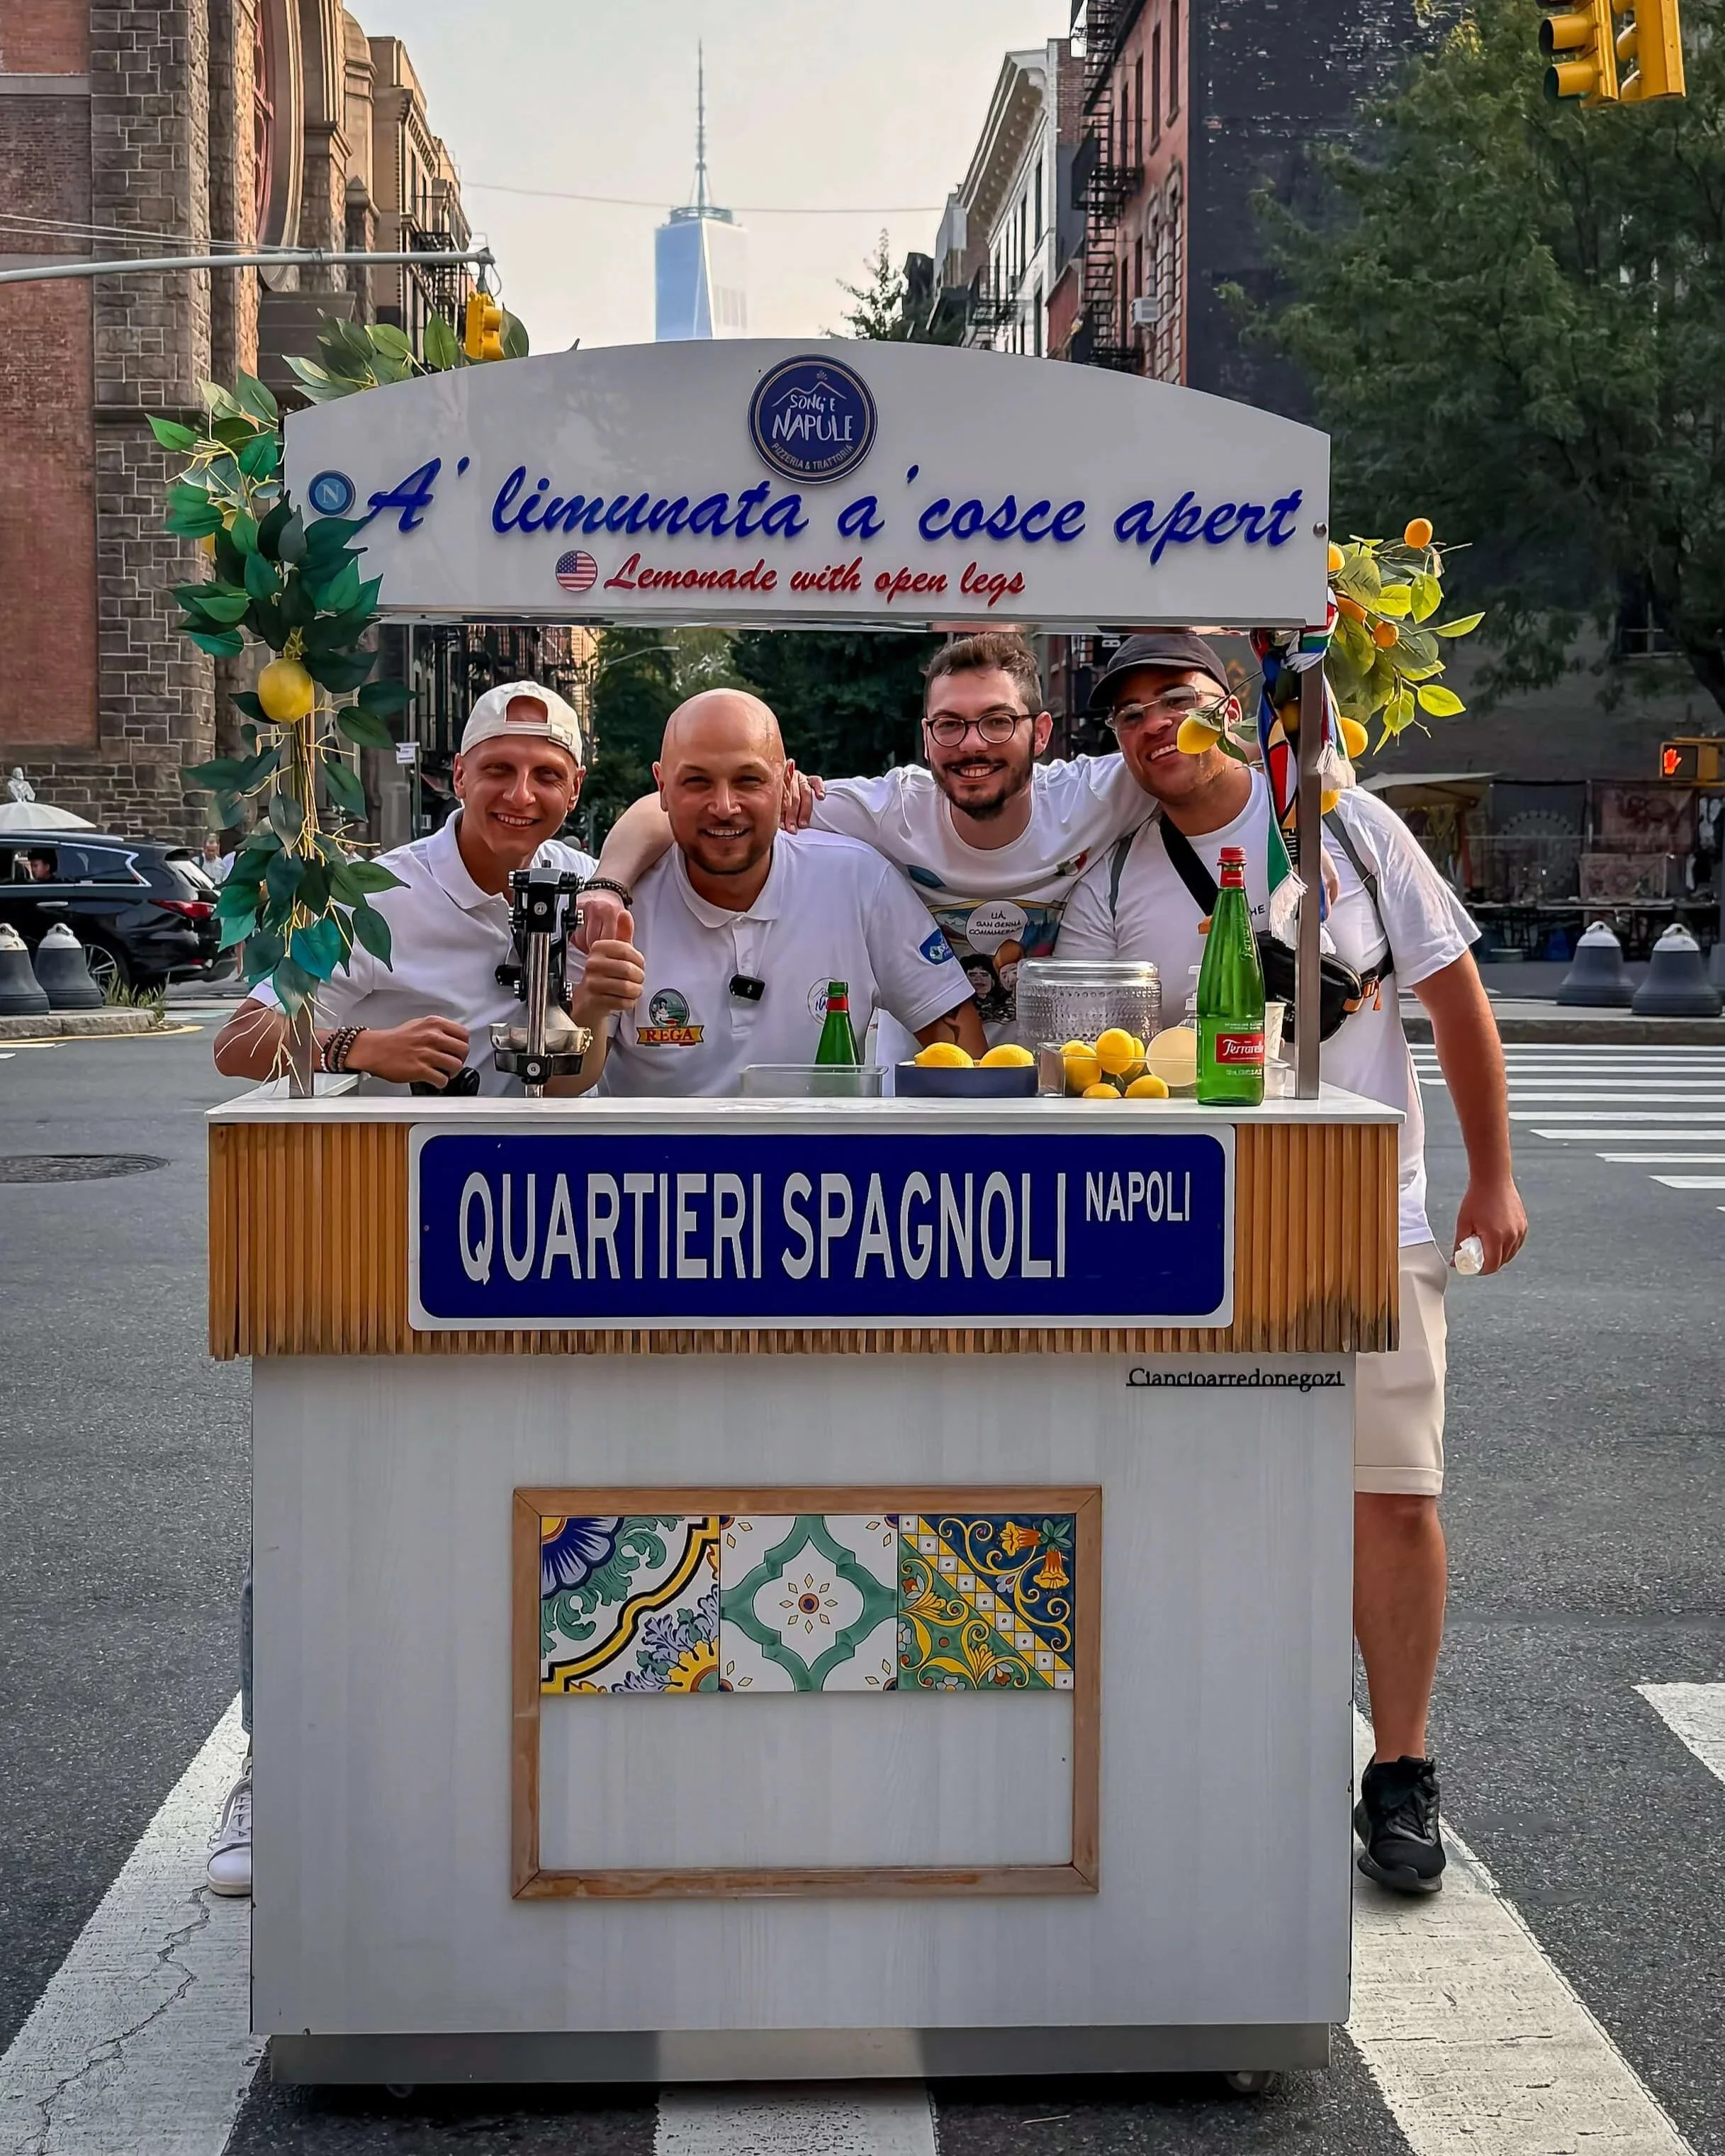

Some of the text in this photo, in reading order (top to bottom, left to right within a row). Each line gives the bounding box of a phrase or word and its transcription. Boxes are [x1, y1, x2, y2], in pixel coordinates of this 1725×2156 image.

[772, 408, 853, 442] NAPULE
[771, 442, 803, 469] PIZZERIA
[813, 444, 854, 470] TRATTORIA
[492, 465, 810, 538] limunata
[1113, 489, 1303, 566] apert
[604, 553, 1026, 607] Lemonade with open legs
[645, 1027, 695, 1042] REGA
[459, 1170, 1191, 1286] QUARTIERI SPAGNOLI NAPOLI
[1127, 1368, 1344, 1393] Ciancioarredonegozi
